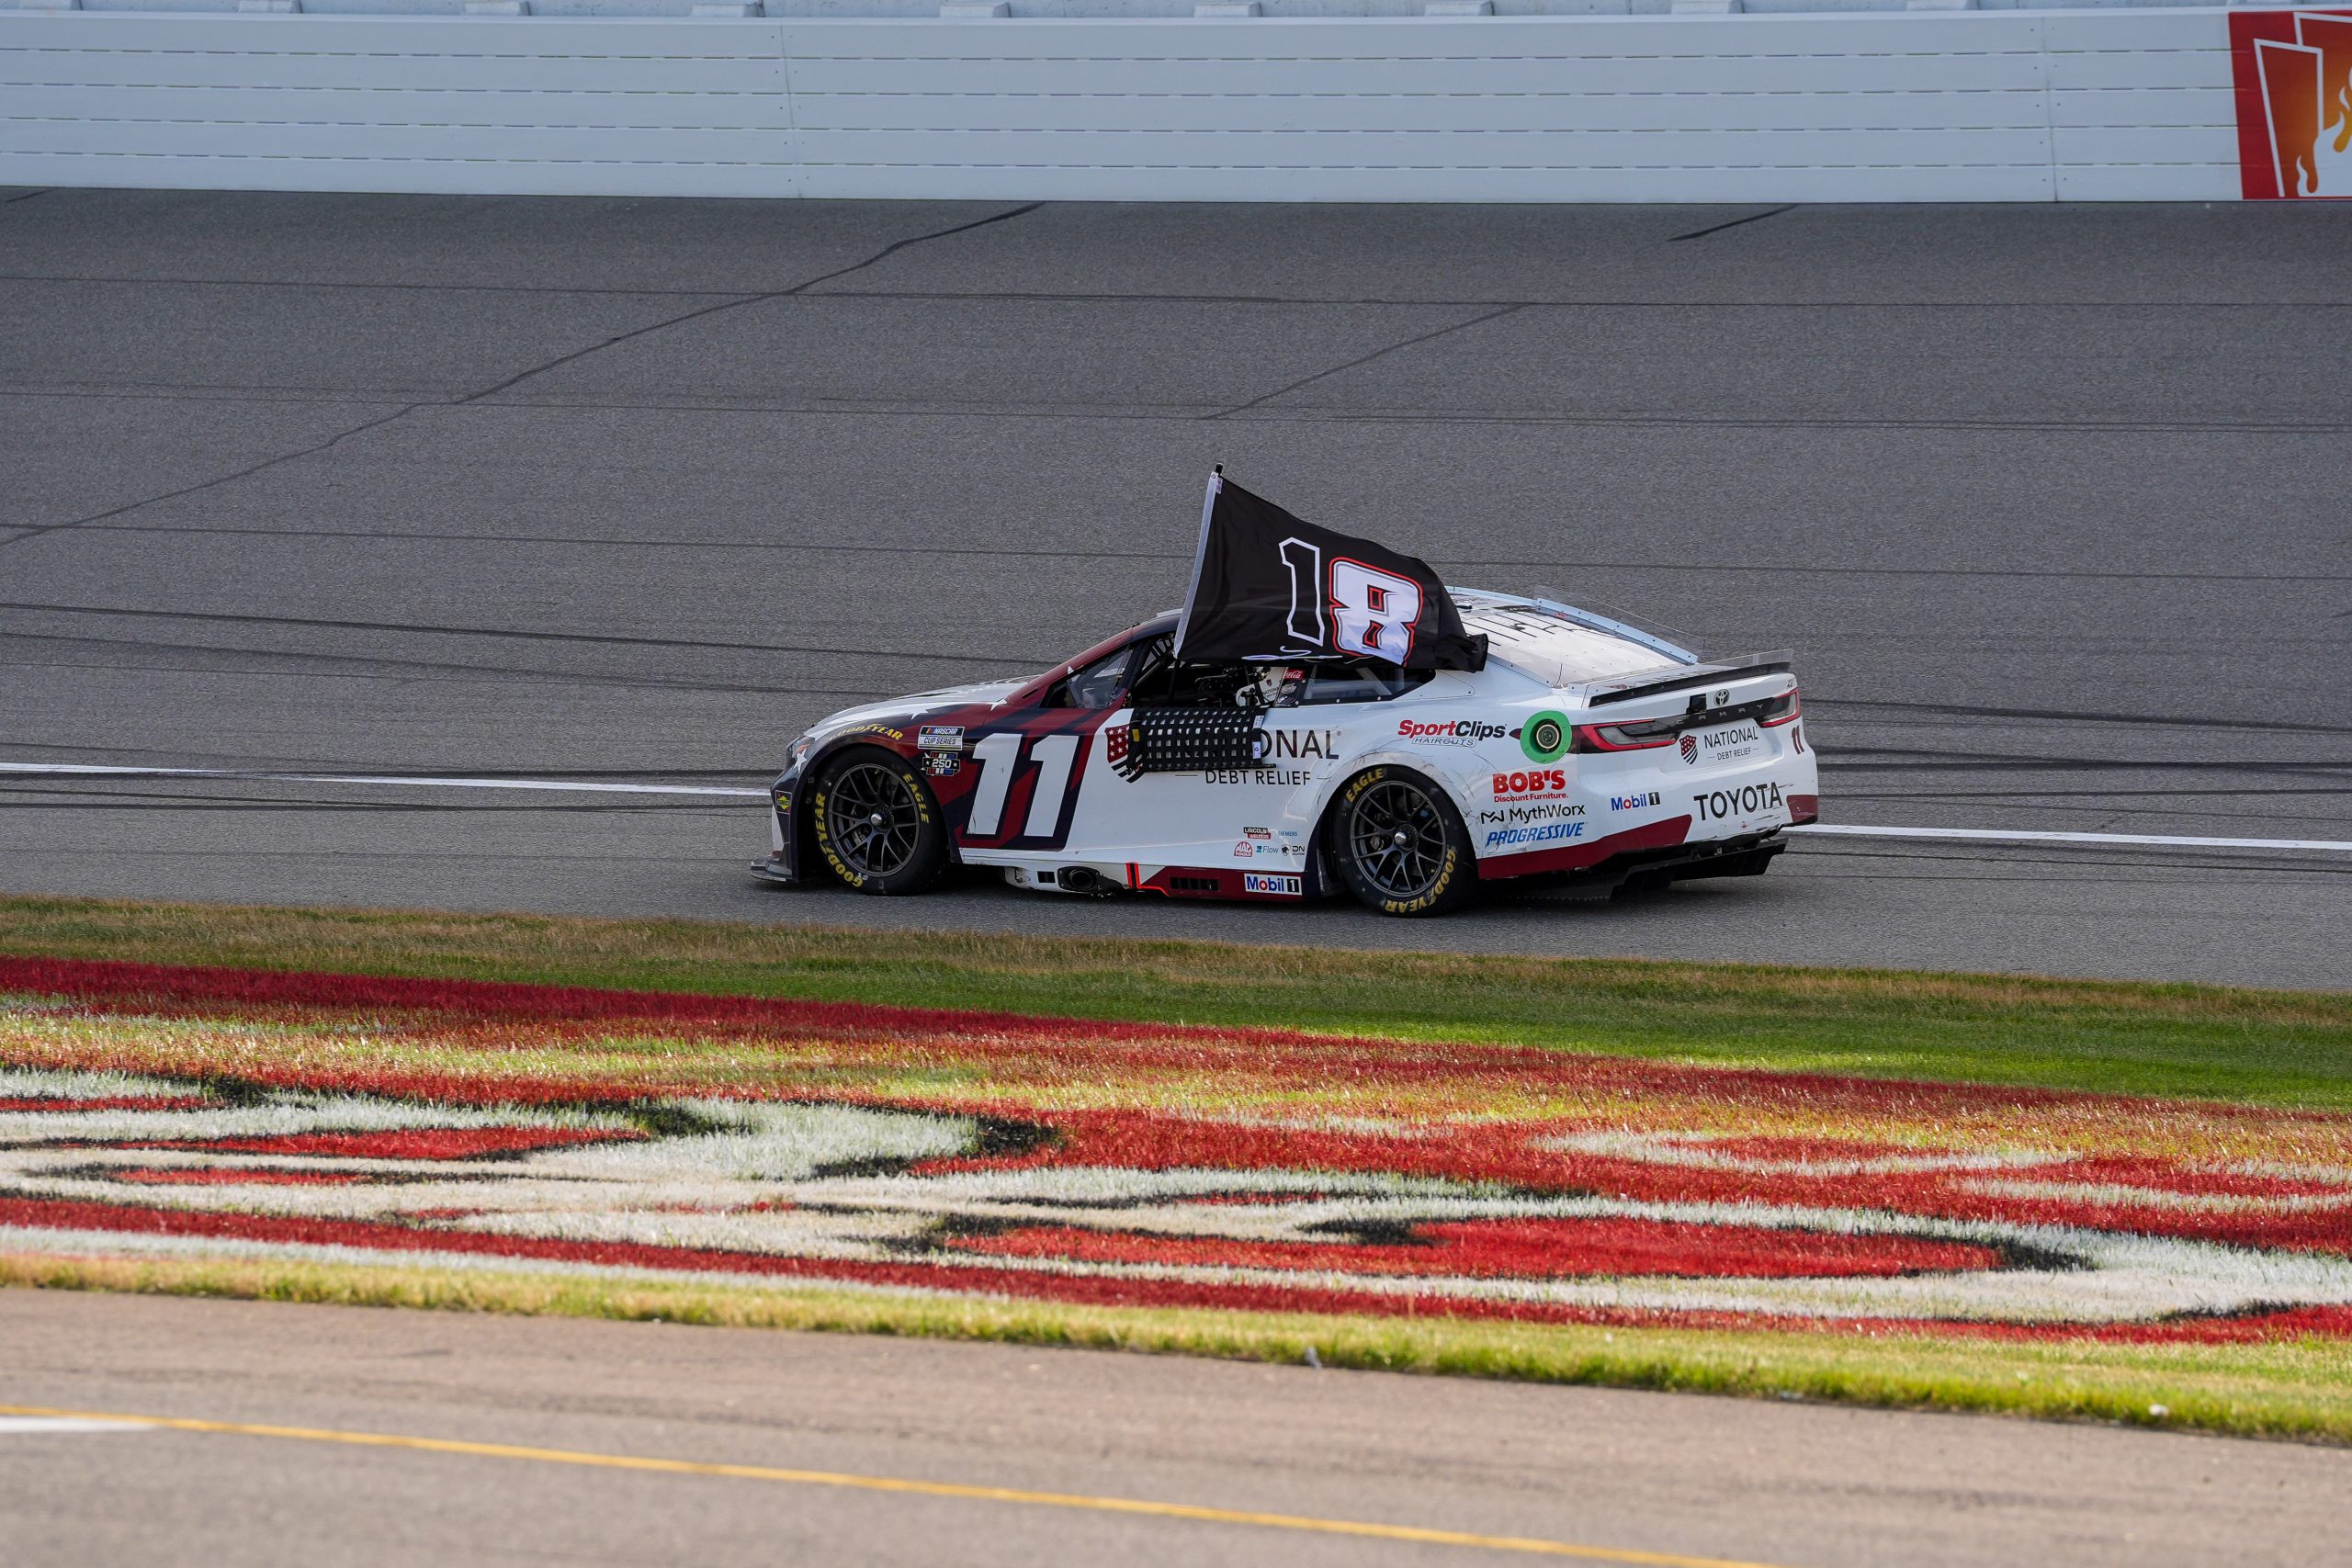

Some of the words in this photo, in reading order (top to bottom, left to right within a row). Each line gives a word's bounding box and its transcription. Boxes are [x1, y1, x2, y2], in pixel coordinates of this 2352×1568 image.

[1676, 704, 1763, 725] CAMRY
[829, 723, 904, 740] GOODYEAR
[1397, 719, 1506, 740] SportClips
[1703, 726, 1758, 749] NATIONAL
[1414, 737, 1475, 746] HAIRCUTS
[932, 760, 952, 768] 250
[1717, 751, 1733, 761] DEBT
[1734, 748, 1752, 758] RELIEF
[967, 733, 1080, 837] 11
[1204, 770, 1249, 784] DEBT
[1255, 771, 1311, 785] RELIEF
[1345, 767, 1384, 803] EAGLE
[1492, 770, 1566, 794] BOB'S
[902, 773, 930, 824] EAGLE
[1494, 795, 1529, 803] Discount
[1611, 794, 1647, 811] Mobil
[1693, 782, 1783, 820] TOYOTA
[1510, 804, 1586, 824] MythWorx
[1485, 821, 1586, 847] PROGRESSIVE
[1246, 876, 1284, 892] Mobil
